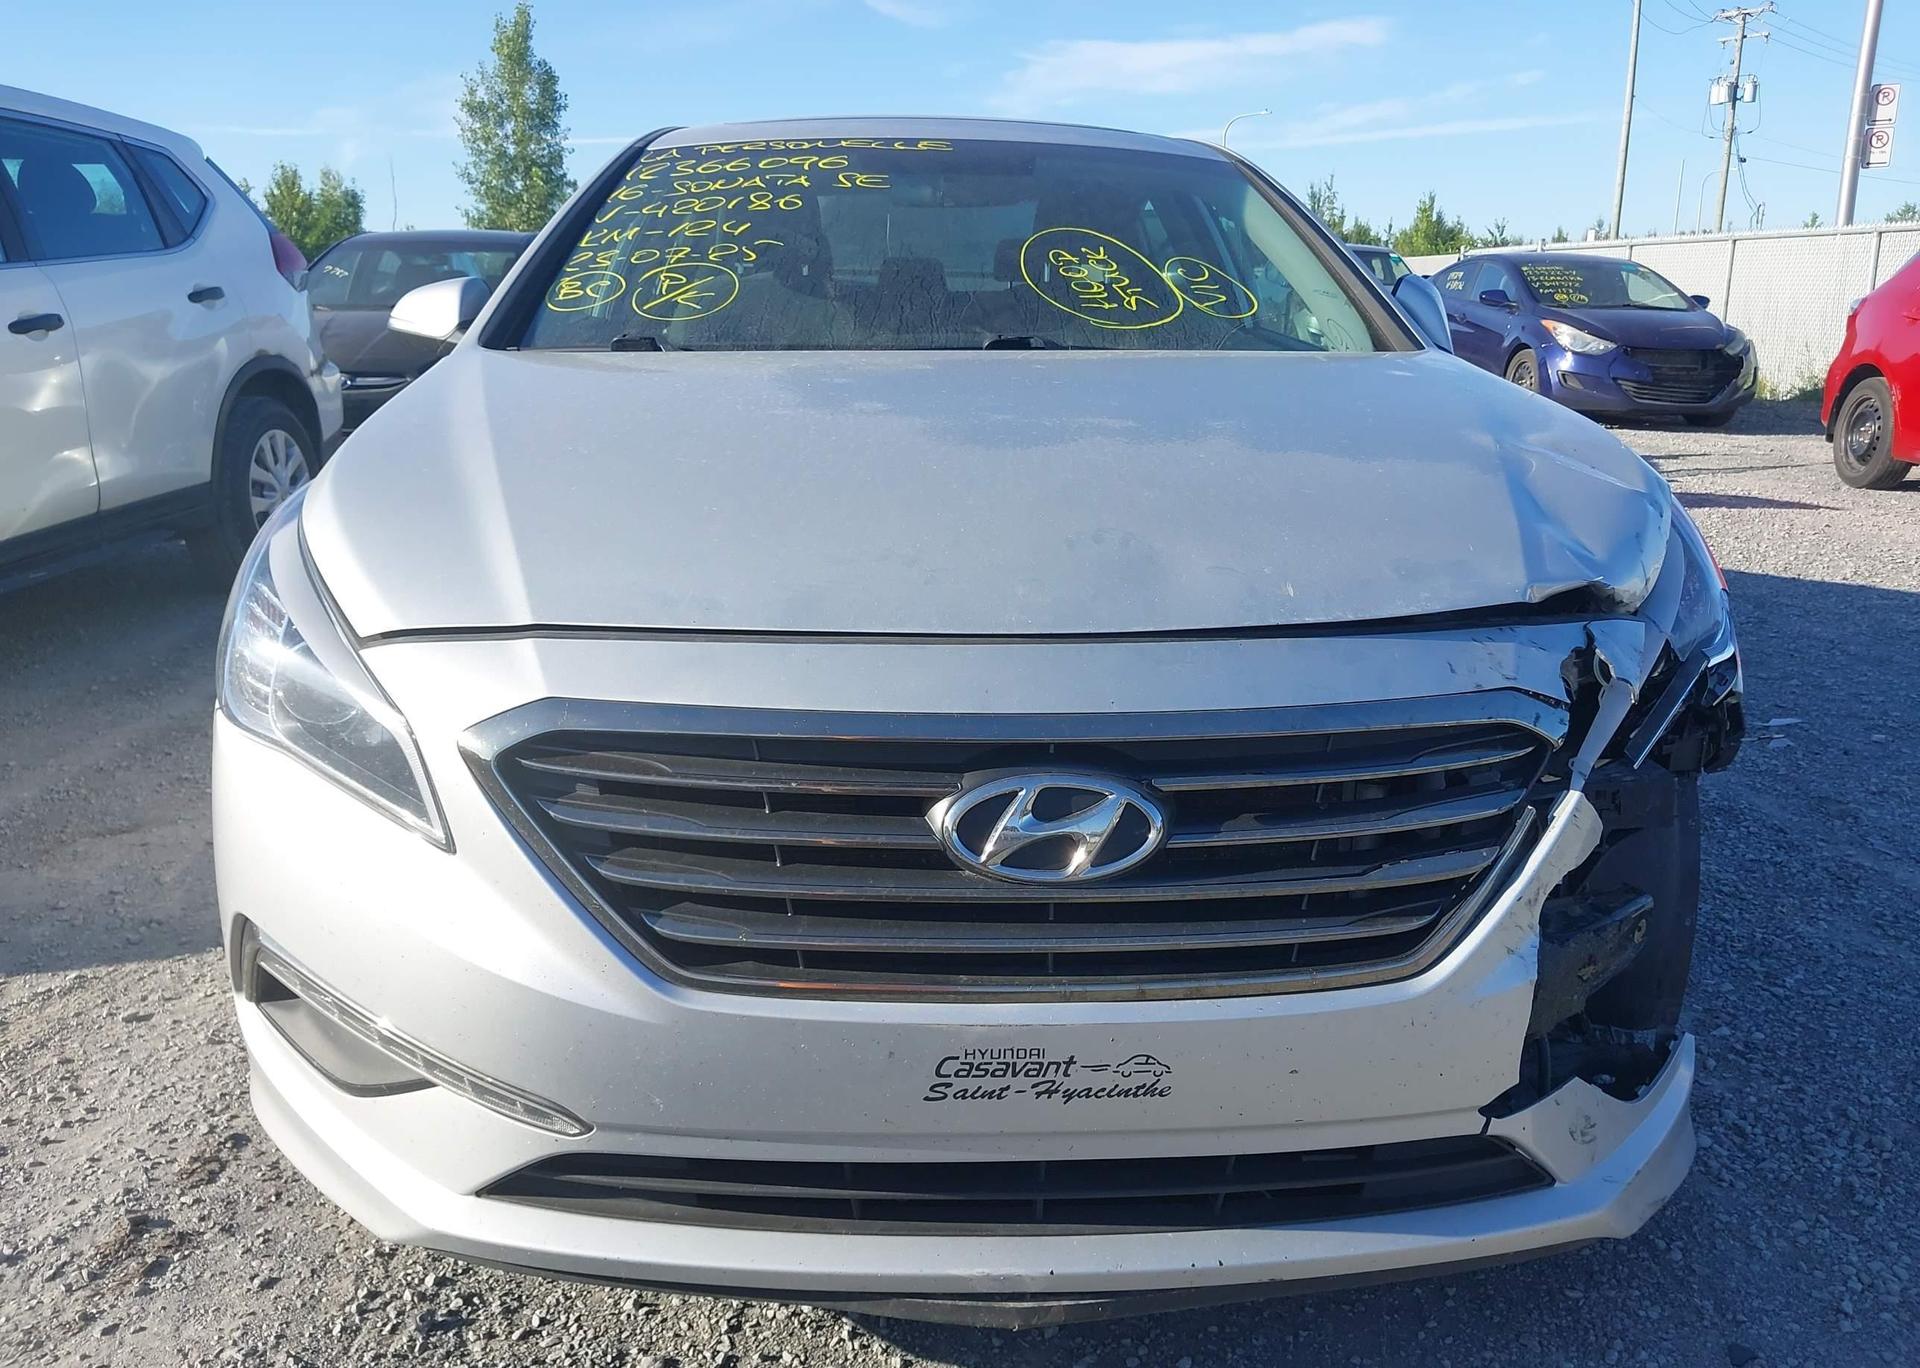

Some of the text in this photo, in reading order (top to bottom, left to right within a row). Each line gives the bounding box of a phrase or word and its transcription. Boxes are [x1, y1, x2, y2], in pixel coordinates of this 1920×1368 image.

[640, 148, 682, 163] LA
[625, 155, 849, 181] 12366096
[832, 172, 893, 189] SE
[963, 1047, 1046, 1060] HYUNDAI
[934, 1054, 1078, 1079] Casavant
